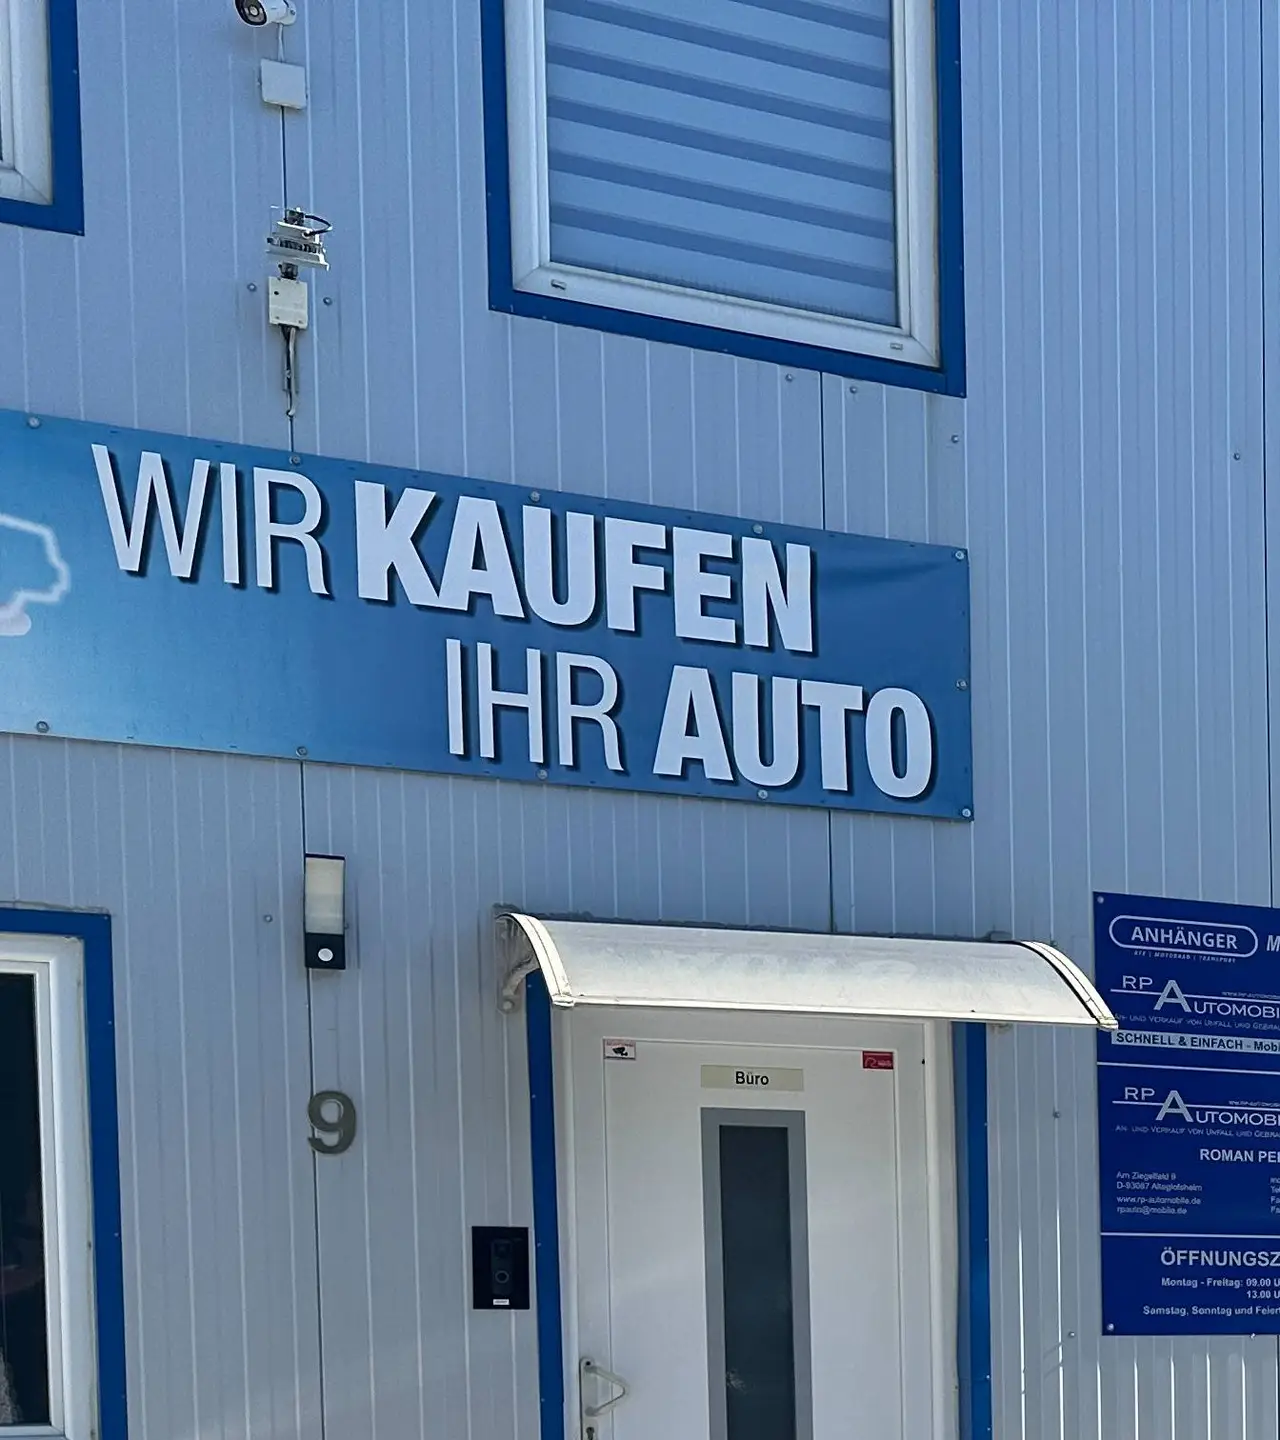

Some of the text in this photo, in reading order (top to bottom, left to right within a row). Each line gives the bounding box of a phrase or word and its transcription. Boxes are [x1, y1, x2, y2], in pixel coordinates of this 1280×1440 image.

[92, 444, 814, 652] WIR KAUFEN
[446, 638, 934, 799] IHR AUTO
[1131, 926, 1238, 949] ANHÄNGER
[1122, 975, 1153, 990] RP
[1116, 1033, 1175, 1046] SCHNELL
[1178, 1036, 1187, 1047] &
[1191, 1037, 1243, 1049] EINFACH
[735, 1071, 769, 1086] Büro
[1124, 1087, 1155, 1101] RP
[307, 1090, 357, 1155] 9
[1200, 1149, 1254, 1162] ROMAN
[1161, 1277, 1197, 1288] Montag
[1207, 1278, 1243, 1289] Freitag:
[1143, 1306, 1189, 1316] Samstag,
[1191, 1306, 1232, 1316] Sonntag
[1235, 1306, 1252, 1315] und
